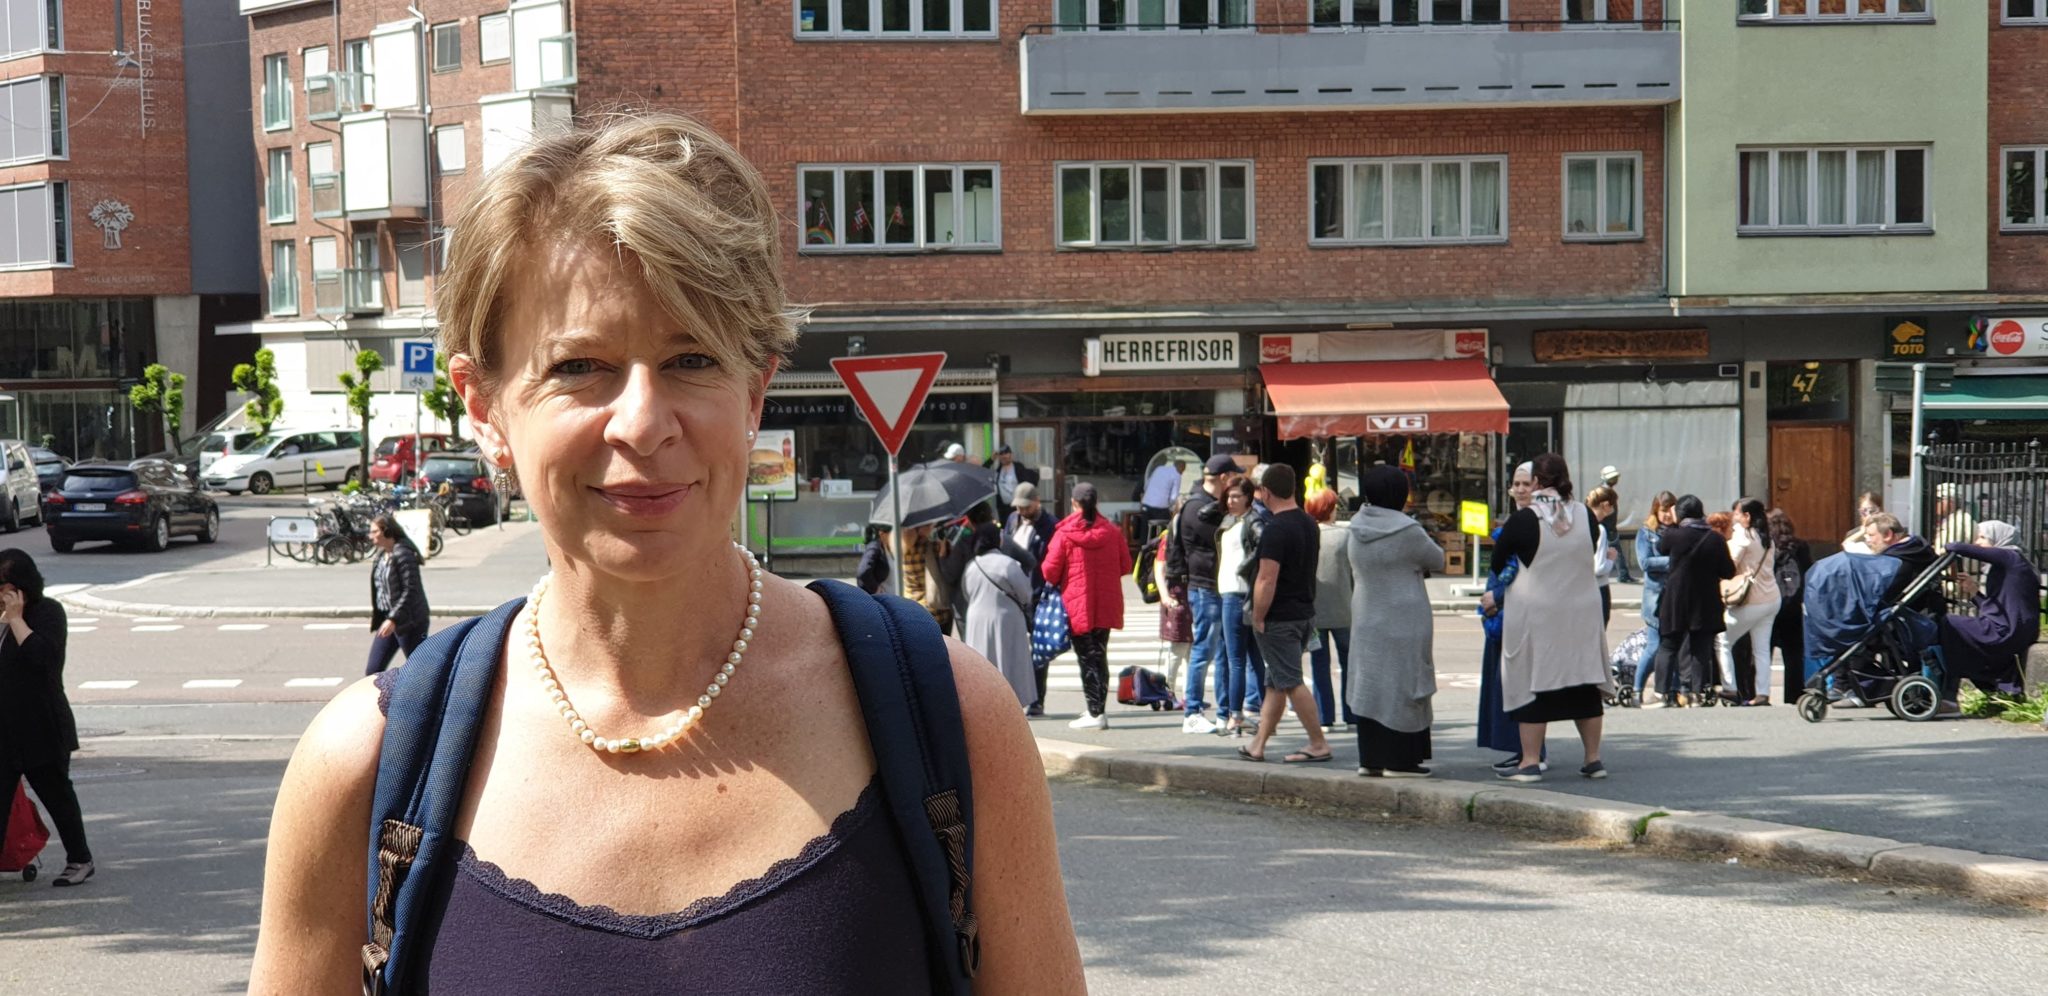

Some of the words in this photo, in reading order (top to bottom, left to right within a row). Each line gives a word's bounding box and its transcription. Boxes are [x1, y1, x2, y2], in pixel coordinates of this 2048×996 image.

[410, 345, 427, 369] P
[1104, 340, 1233, 362] HERREFRISØR
[1893, 344, 1925, 354] TOTO
[1792, 373, 1818, 392] 47
[1371, 415, 1422, 429] VG
